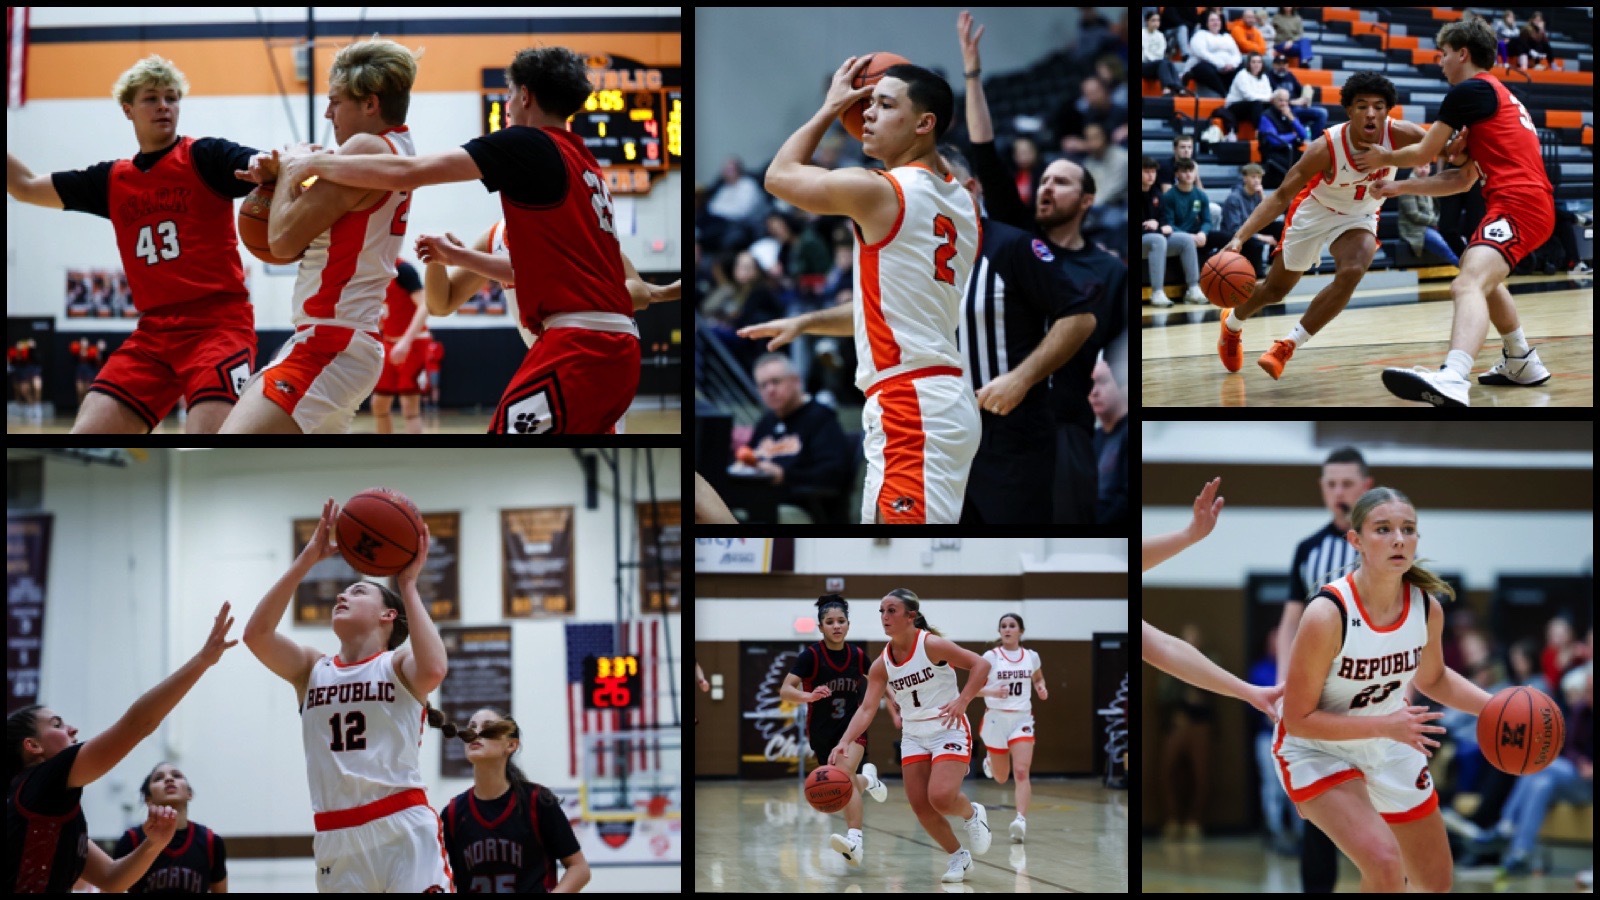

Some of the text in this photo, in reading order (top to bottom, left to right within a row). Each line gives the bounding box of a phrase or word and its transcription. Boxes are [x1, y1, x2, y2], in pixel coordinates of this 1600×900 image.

[135, 219, 181, 266] 43
[933, 213, 957, 286] 2
[997, 669, 1033, 680] REPUBLI
[1337, 646, 1422, 680] REPUBLI
[307, 681, 396, 710] REPUBLIC
[592, 675, 631, 707] 26
[825, 676, 859, 695] ORTH
[911, 689, 921, 708] 1
[1008, 681, 1023, 697] 10
[1348, 679, 1402, 710] 23
[831, 698, 847, 720] 3
[328, 710, 368, 753] 12
[463, 838, 524, 872] NORTH
